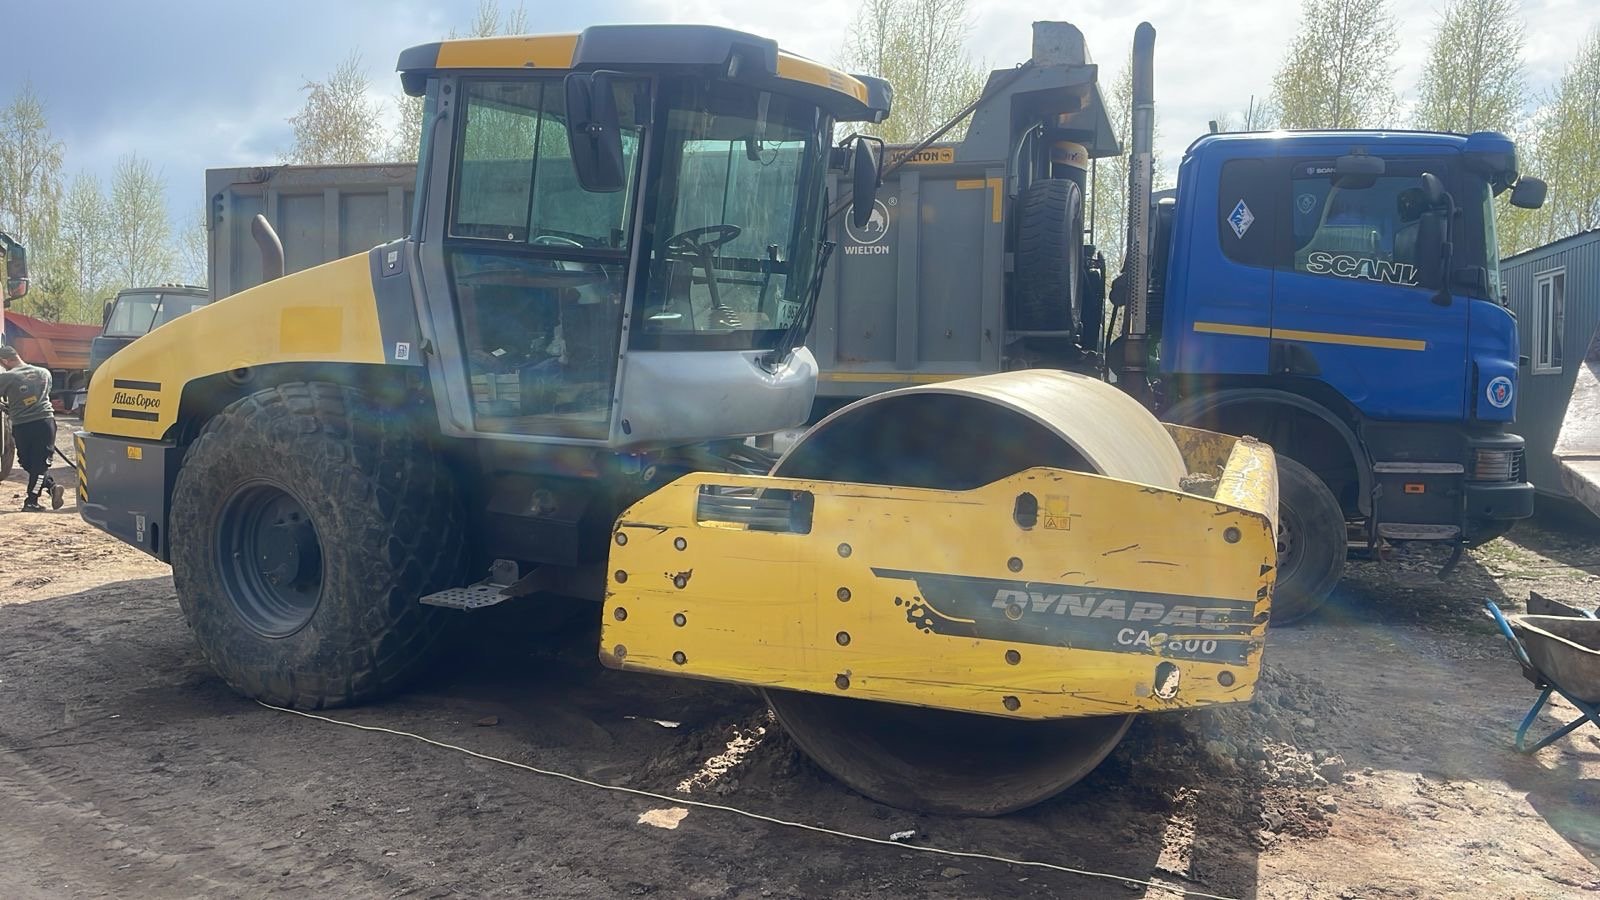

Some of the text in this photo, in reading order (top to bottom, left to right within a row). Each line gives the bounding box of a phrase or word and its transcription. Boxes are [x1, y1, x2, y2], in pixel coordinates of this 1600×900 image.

[844, 246, 889, 254] WIELTON
[1306, 252, 1419, 286] SCANI
[112, 391, 161, 409] Atlas Copco
[992, 588, 1233, 631] DYNAPAC
